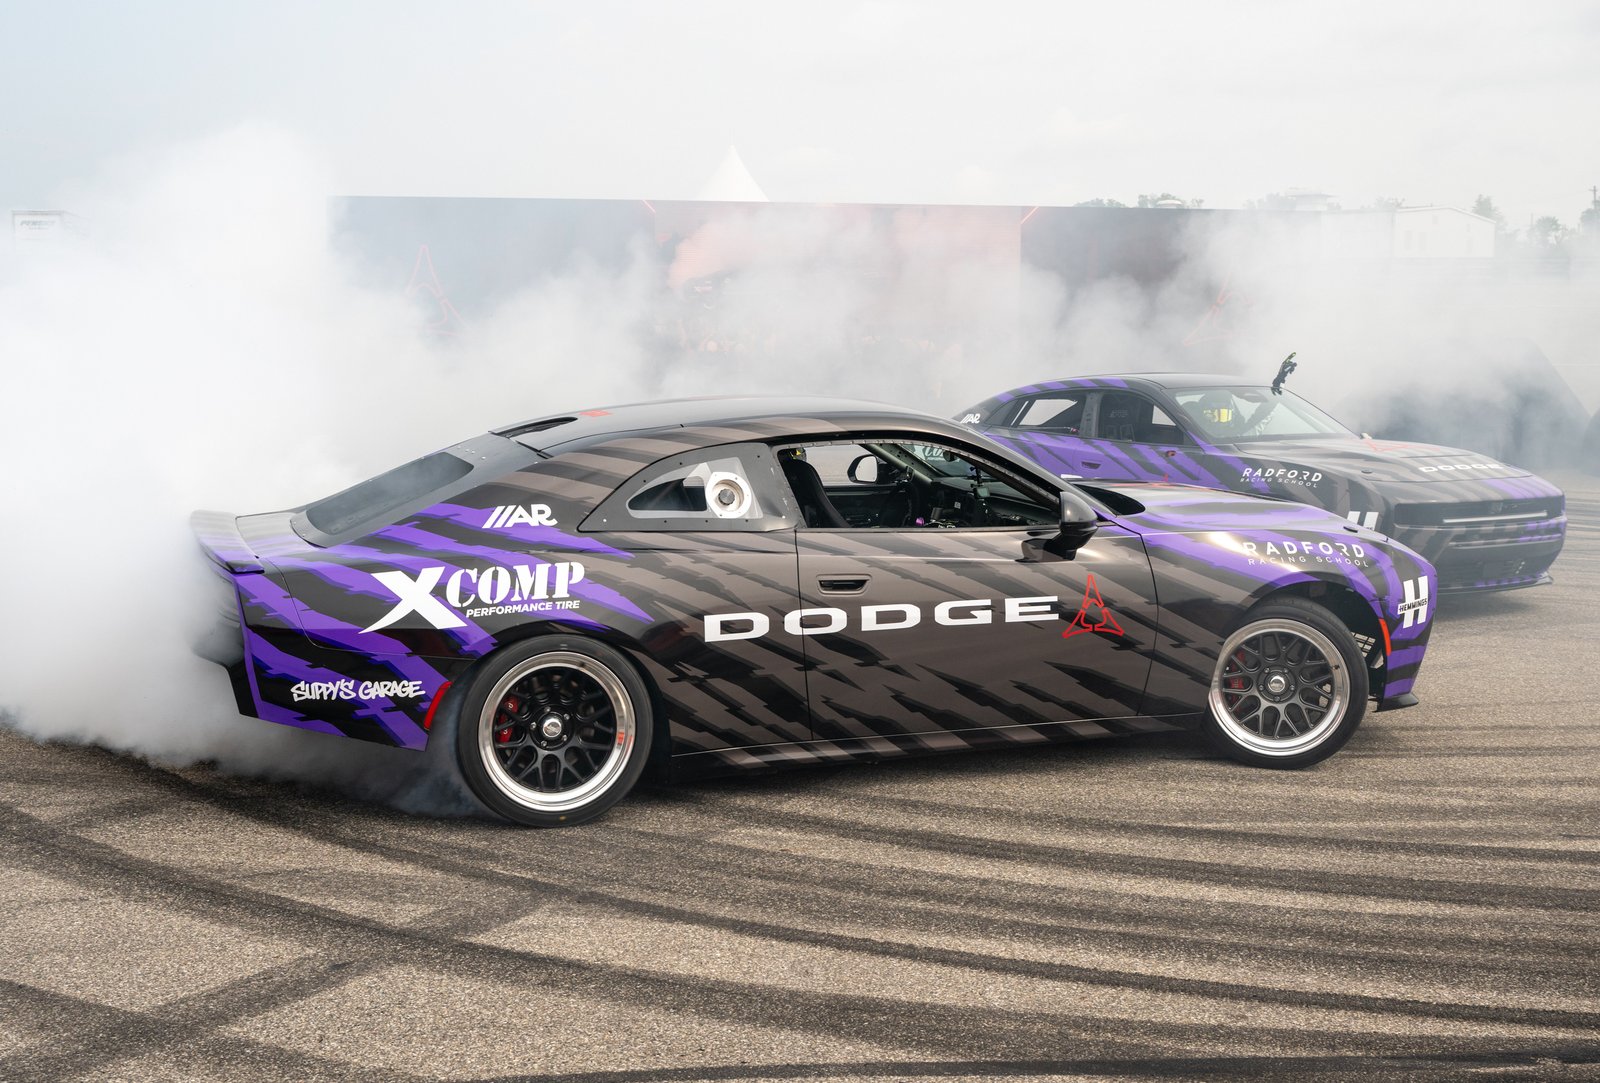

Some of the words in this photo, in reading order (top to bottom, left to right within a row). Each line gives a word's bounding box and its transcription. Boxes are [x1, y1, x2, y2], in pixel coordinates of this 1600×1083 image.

[1242, 467, 1323, 483] RADFORD
[1418, 463, 1504, 473] DODGE
[1239, 476, 1273, 484] RACING
[1277, 478, 1319, 489] SCHOOL
[1242, 541, 1365, 558] RADFORD
[1247, 556, 1306, 566] RACING
[1315, 556, 1369, 568] SCHOOL
[466, 601, 552, 618] PERFORMANCE
[555, 600, 580, 611] TIRE
[1398, 598, 1428, 613] HEMMINGS
[704, 595, 1059, 643] DODGE
[290, 679, 357, 702] SUPPY'S
[358, 680, 426, 700] GARAGE
